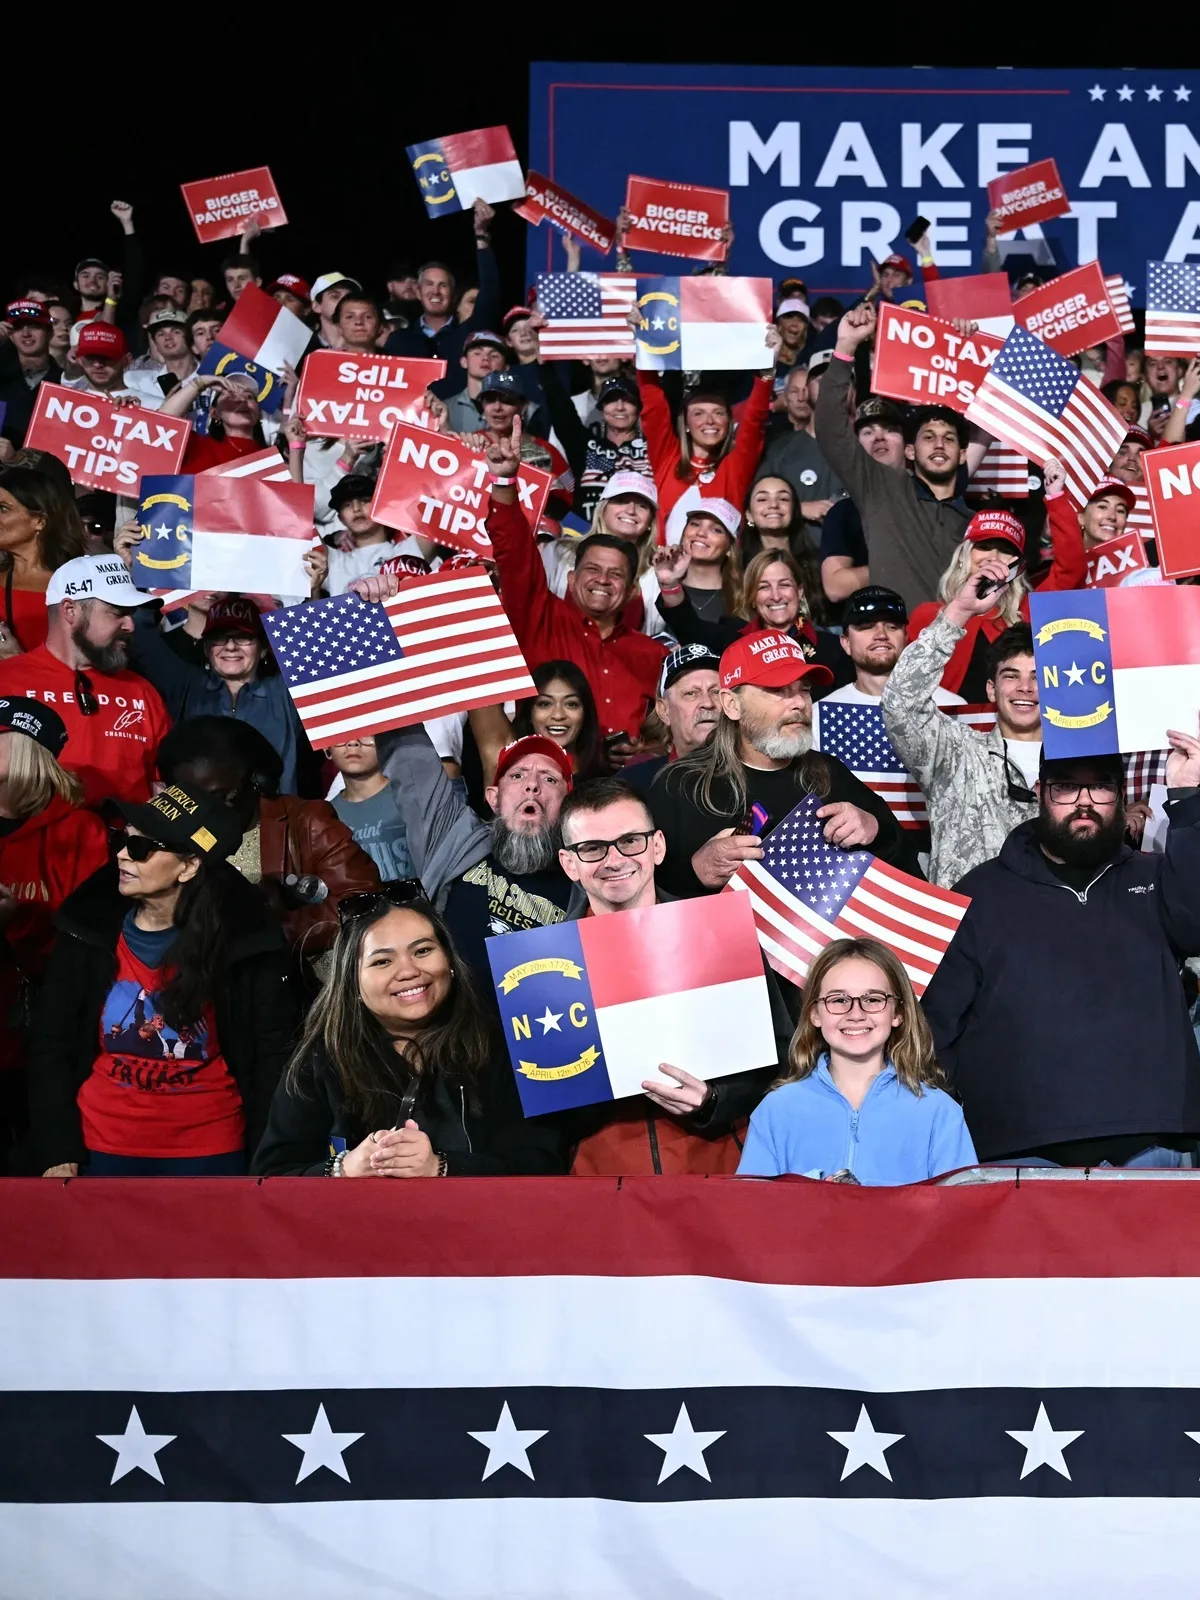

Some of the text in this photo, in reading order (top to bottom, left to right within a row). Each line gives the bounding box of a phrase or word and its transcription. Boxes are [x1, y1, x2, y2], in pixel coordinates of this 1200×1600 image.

[729, 122, 1032, 188] MAKE
[440, 170, 449, 182] C
[205, 189, 259, 211] BIGGER
[1002, 181, 1046, 204] BIGGER
[195, 196, 278, 225] PAYCHECKS
[526, 186, 610, 249] PAYCHECKS
[544, 188, 598, 228] BIGGER
[646, 204, 708, 226] BIGGER
[1026, 293, 1086, 332] BIGGER
[1034, 300, 1110, 343] YCHECKS
[640, 317, 677, 330] N C
[886, 318, 1000, 368] NO TAX
[931, 354, 958, 374] ON
[338, 362, 408, 389] TIPS
[908, 366, 976, 404] TIPS
[356, 388, 384, 402] ON
[306, 399, 370, 427] TAX
[45, 398, 178, 452] NO TAX
[91, 436, 122, 454] ON
[64, 444, 139, 484] TIPS
[398, 438, 540, 510] NO TX
[450, 484, 482, 508] ON
[978, 513, 1000, 522] MAKE
[140, 524, 188, 540] N C
[96, 564, 119, 574] MAKE
[383, 557, 426, 576] MAGA
[64, 579, 94, 596] 45-47
[106, 574, 130, 586] GREAT
[210, 602, 253, 622] MAGA
[1044, 622, 1060, 634] MAY
[748, 634, 778, 655] MAKE
[762, 647, 790, 664] GREAT
[1044, 661, 1106, 688] N C
[26, 690, 146, 710] FREDOM
[11, 718, 39, 737] AMERICA
[13, 712, 34, 723] GOLDEN
[1053, 716, 1072, 726] APRIL
[105, 730, 132, 739] CHARLIE
[152, 797, 182, 822] AGAIN
[350, 819, 383, 840] aint
[488, 898, 534, 930] AGLES
[507, 961, 569, 982] MAY 20th 1775
[512, 1002, 588, 1041] N C
[528, 1058, 590, 1079] APRIL 12th 1776
